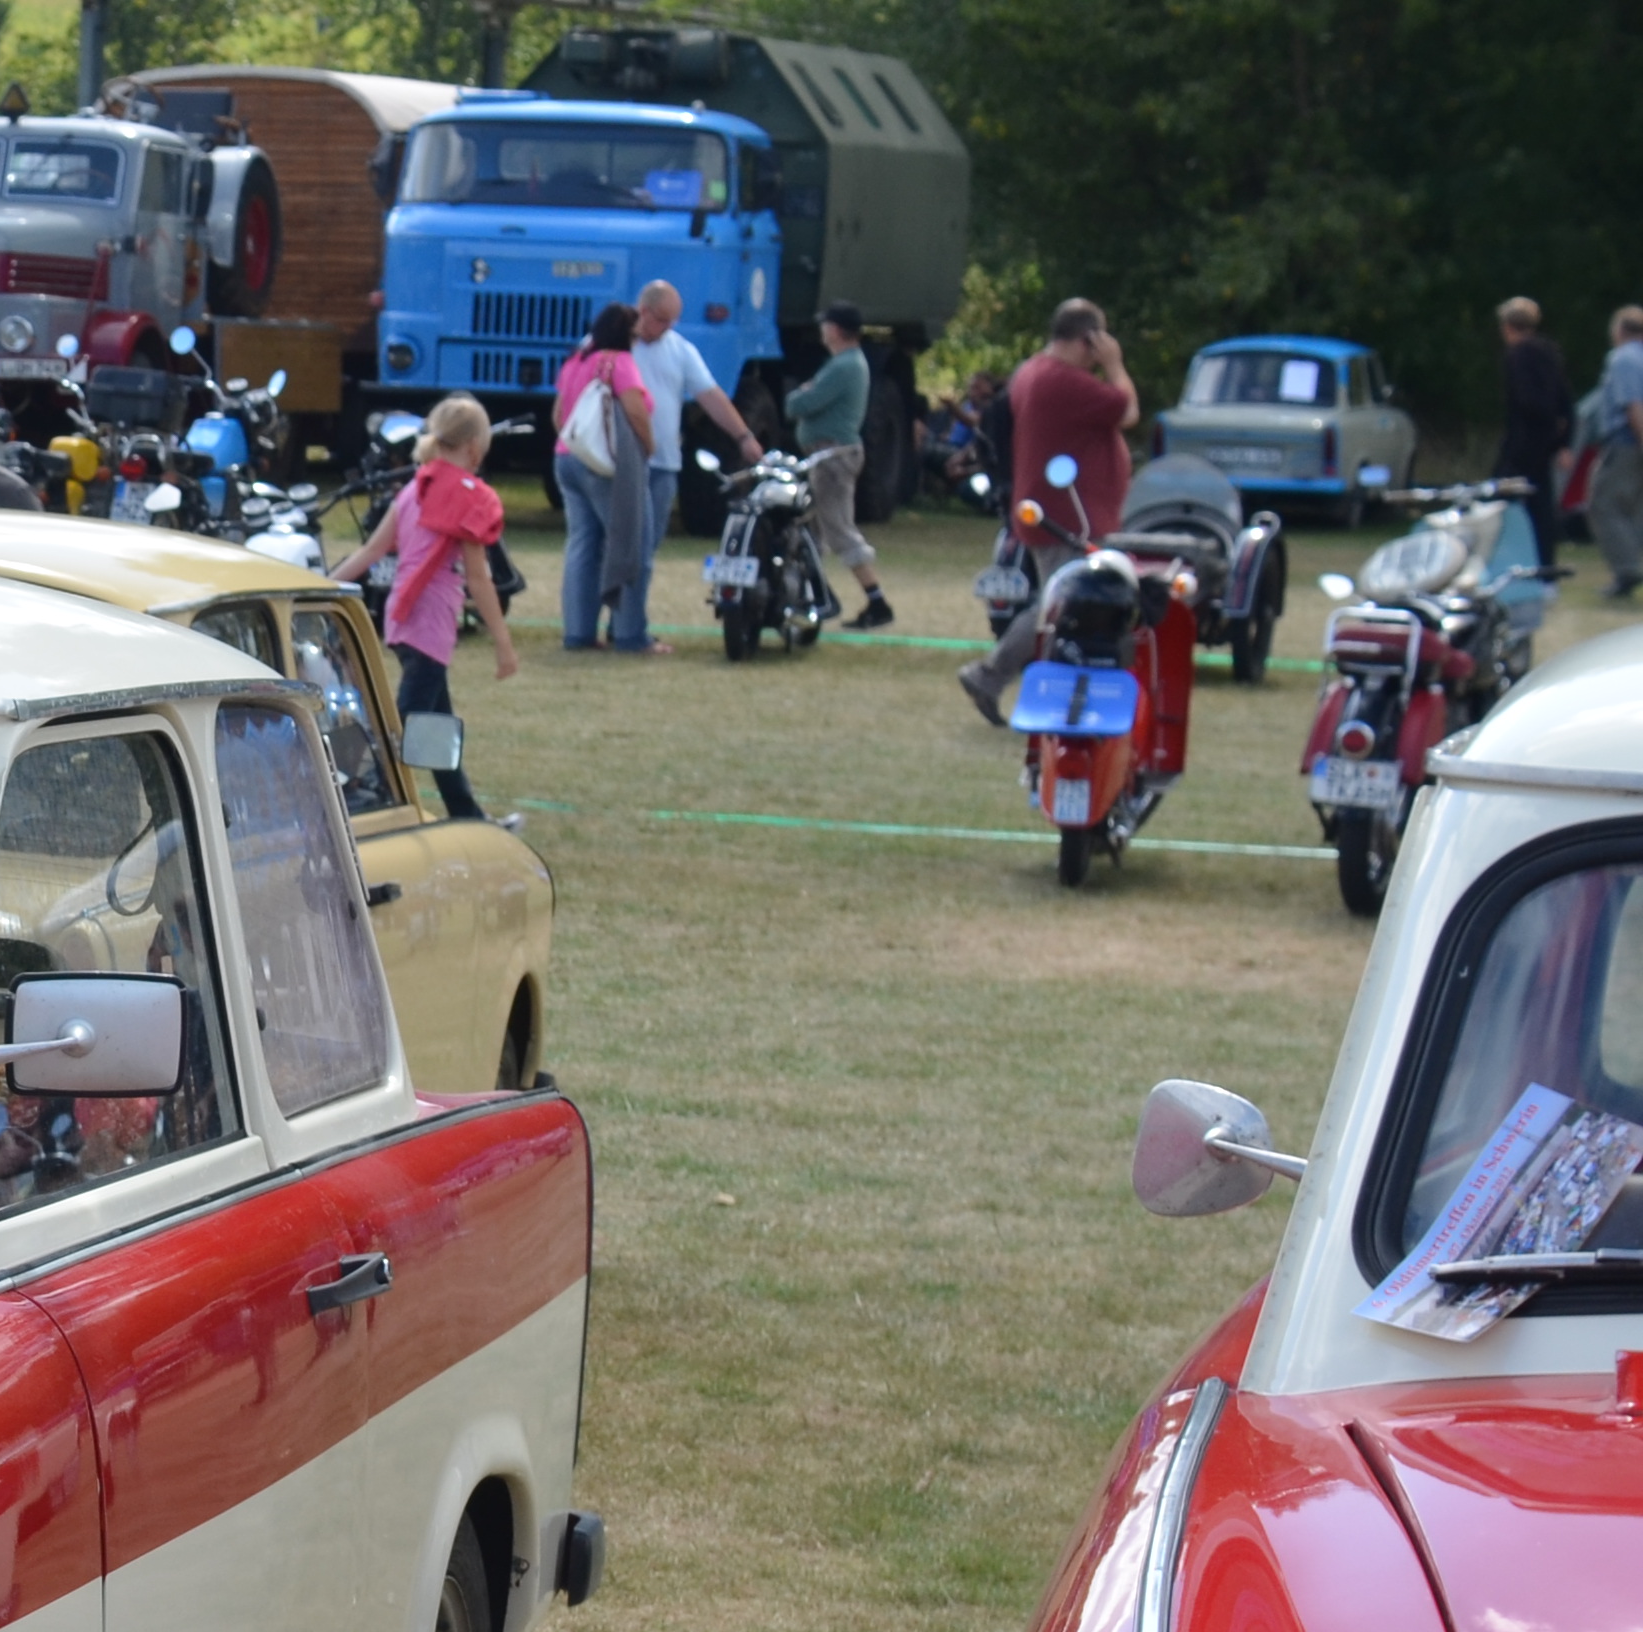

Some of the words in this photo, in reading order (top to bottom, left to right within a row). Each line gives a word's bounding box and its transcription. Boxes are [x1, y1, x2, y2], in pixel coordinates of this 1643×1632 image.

[1384, 1191, 1476, 1297] Oldtimertreffen
[1469, 1174, 1489, 1190] in
[1483, 1102, 1541, 1171] Schwerin
